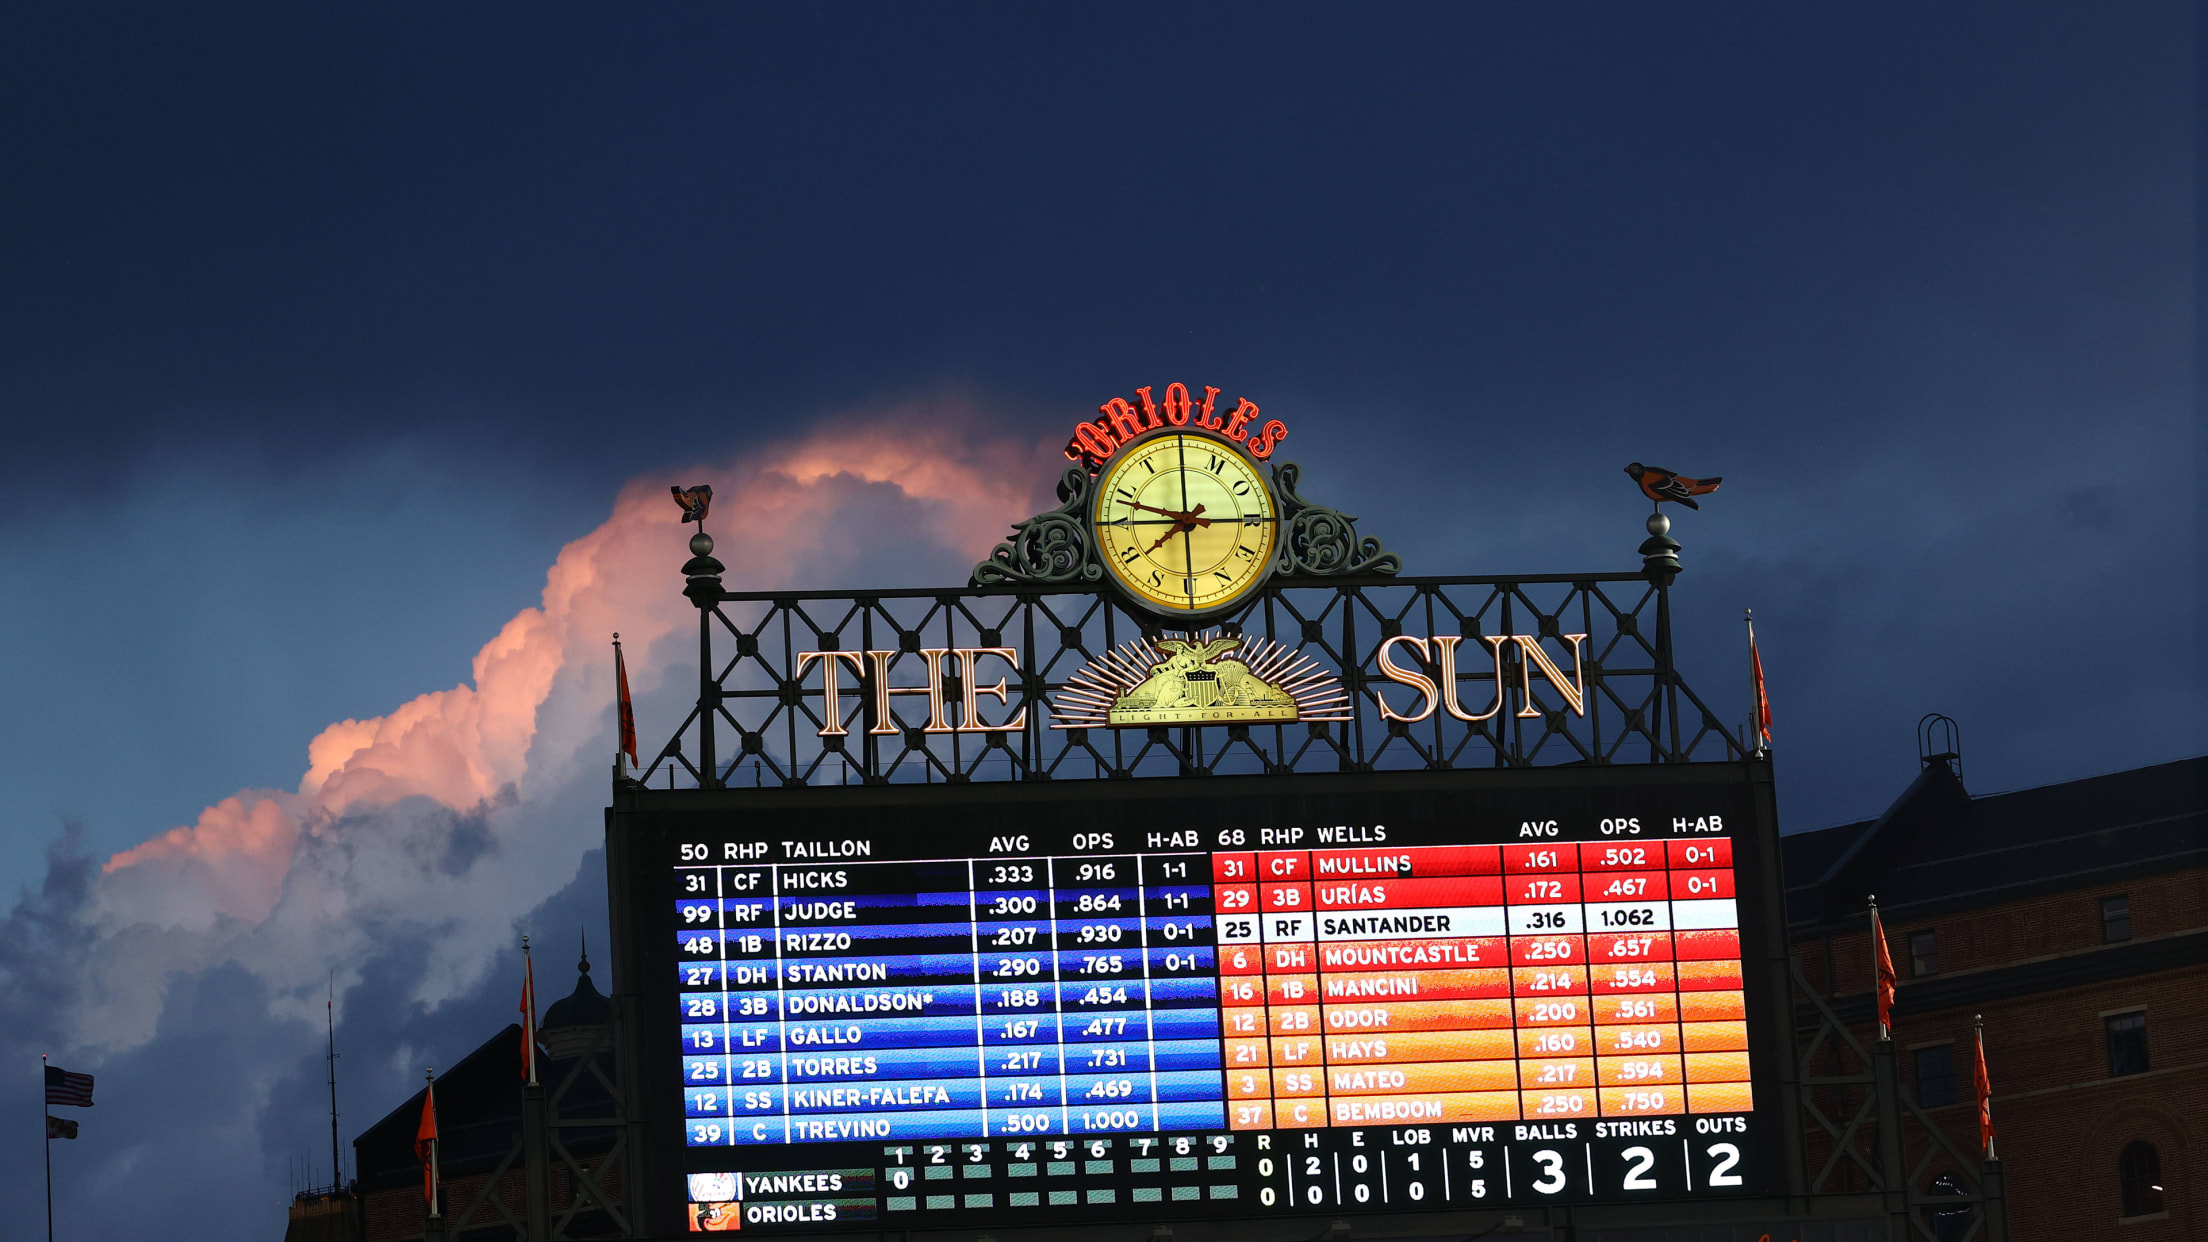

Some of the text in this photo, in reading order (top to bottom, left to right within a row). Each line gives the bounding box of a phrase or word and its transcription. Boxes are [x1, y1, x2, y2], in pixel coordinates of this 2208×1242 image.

[1074, 382, 1289, 461] ORIOLES
[796, 633, 1588, 736] THE SUN
[1119, 709, 1288, 722] LIGHT FOR ALL
[681, 831, 1198, 860] 50 RHP TAILLON AVG OPS H-AB
[1219, 816, 1722, 845] 68 RHP WELLS AVG OPS H-AB
[1224, 847, 1713, 876] 31 CF MULLINS .161 .502 0-1
[686, 863, 1185, 891] 31 CF HICKS .333 .916 1-1
[1223, 877, 1716, 907] 29 3B URÍAS .172 .467 0-1
[683, 893, 1188, 923] 99 RF JUDGE .300 .864 1-1
[685, 923, 1193, 953] 48 1B RIZZO .207 .930 0-1
[1226, 909, 1653, 938] 25 RF SANTANDER .316 1.062
[1234, 940, 1652, 968] 6 DH MOUNTCASTLE .250 .657
[687, 954, 1195, 985] 27 DH STANTON .290 .765 0-1
[1230, 971, 1655, 1000] 16 1B MANCINI .214 .554
[688, 999, 716, 1016] 28
[740, 998, 767, 1015] 3B
[998, 990, 1039, 1007] .188
[1080, 986, 1127, 1004] .454
[1233, 1002, 1655, 1031] 12 2B ODOR .200 .561
[691, 1018, 1126, 1047] 13 LF GALLO .167 .477
[1236, 1032, 1661, 1062] 21 LF HAYS .160 .540
[691, 1050, 1126, 1080] 25 2B TORRES .217 .731
[1242, 1062, 1663, 1093] 3 SS MATEO .217 .594
[694, 1080, 1132, 1111] 12 SS KINER-FALEFA .174 .469
[1237, 1093, 1664, 1124] 37 C BEMBOOM .250 .750
[694, 1111, 1139, 1142] 39 C TREVINO .500 1.000
[896, 1117, 1746, 1164] 1 2 3 4 5 6 7 8 9 R H E LOB MVR BALLS STRIKES OUTS
[746, 1151, 1483, 1193] YANKEES 0 0 2 0 1 5
[1533, 1143, 1742, 1193] 3 2 2
[748, 1180, 1485, 1223] ORIOLES 0 0 0 0 5
